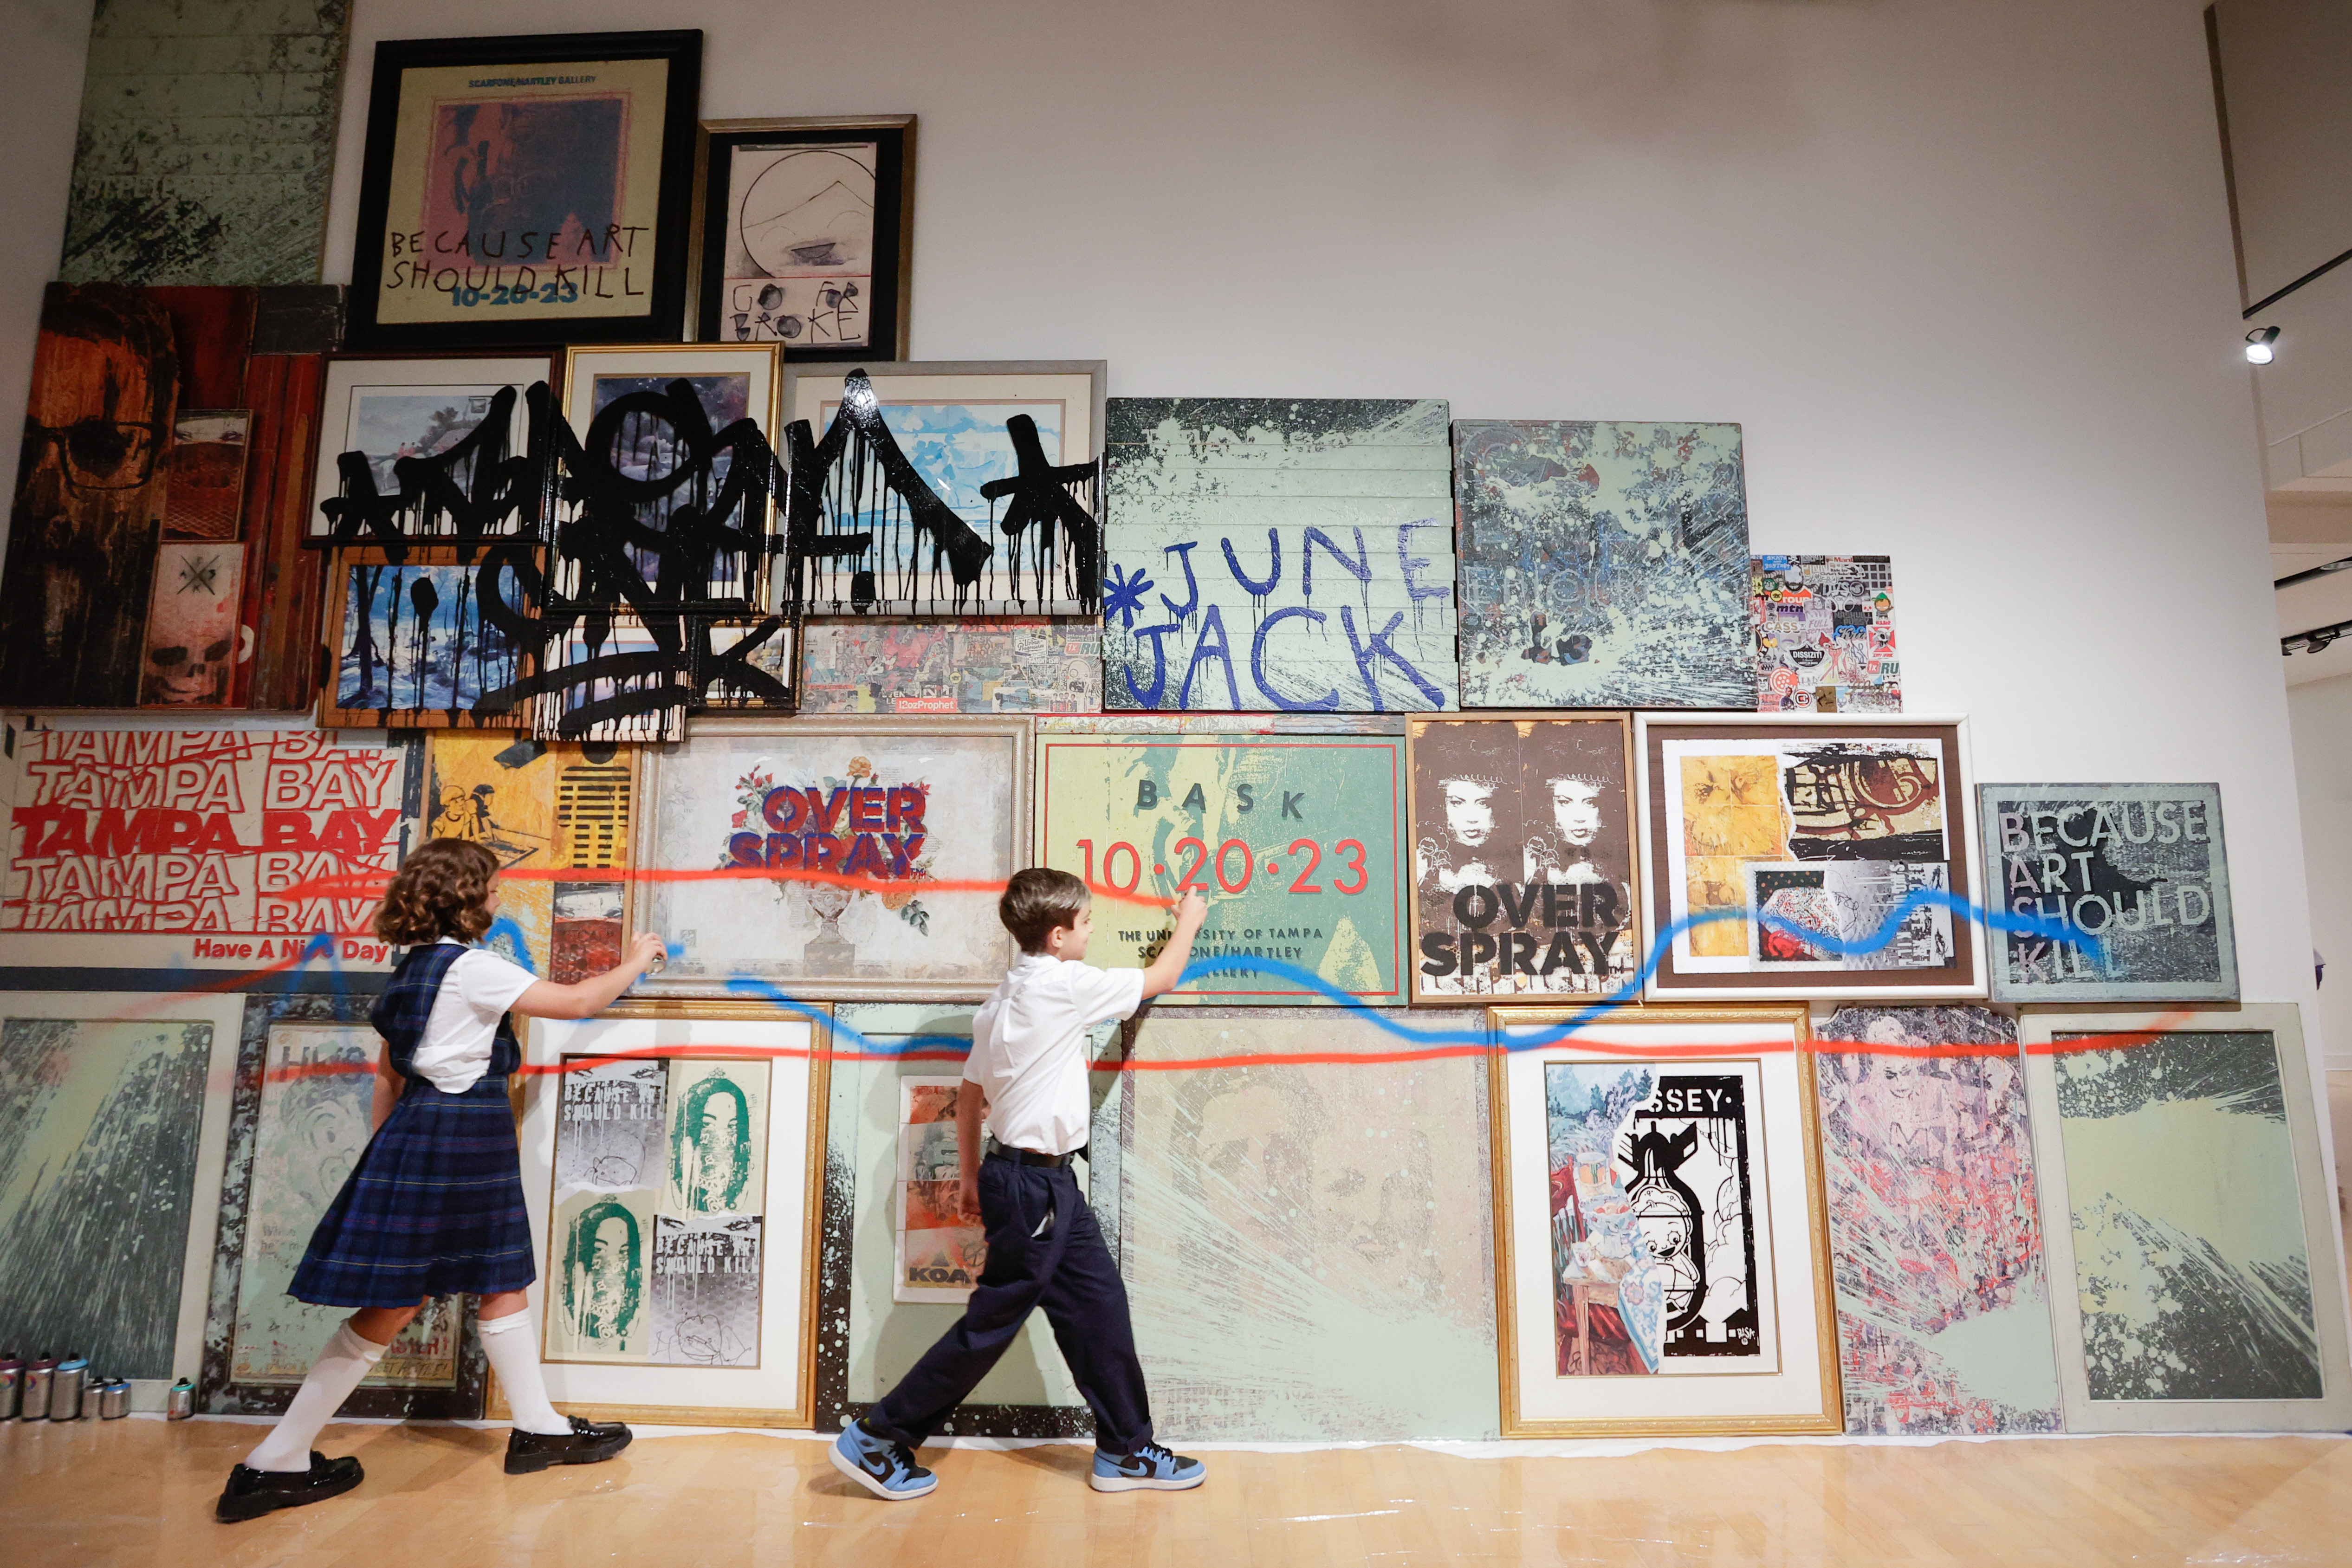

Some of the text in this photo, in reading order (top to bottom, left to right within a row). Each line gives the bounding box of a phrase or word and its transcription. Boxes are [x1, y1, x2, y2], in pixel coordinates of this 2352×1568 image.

[558, 75, 596, 84] GALLERY
[391, 223, 649, 259] BECAUSE ART
[386, 259, 644, 298] SHOULD KILL
[452, 282, 578, 306] 10-20-23
[732, 283, 783, 311] GO
[729, 308, 861, 343] BROKE
[1160, 518, 1451, 620] JUNE
[1124, 604, 1445, 711] JACK
[899, 700, 954, 711] 12ozProphet
[27, 758, 398, 813] TAMPA BAY
[1137, 779, 1306, 821] BASK
[762, 786, 927, 834] OVER
[1999, 800, 2210, 852] BECAUSE
[12, 807, 403, 858] TAMPA BAY
[724, 831, 925, 880] SPRAY
[2009, 850, 2094, 895] ART
[11, 853, 240, 901] TAMPA
[1453, 883, 1619, 929] OVER
[2012, 882, 2211, 939] SHOULD
[194, 938, 252, 959] Have
[258, 939, 275, 959] A
[343, 940, 389, 963] Day
[1119, 931, 1141, 942] THE
[1244, 928, 1263, 939] OF
[1269, 928, 1323, 939] TAMPA
[1421, 931, 1620, 976] SPRAY
[2018, 937, 2125, 984] KILL
[564, 1084, 629, 1103] BECAUSE
[564, 1103, 665, 1121] SHOULD KILL
[655, 1256, 760, 1274] SHOULD KILL
[656, 1237, 724, 1256] BECAUSE
[909, 1267, 971, 1283] KOA
